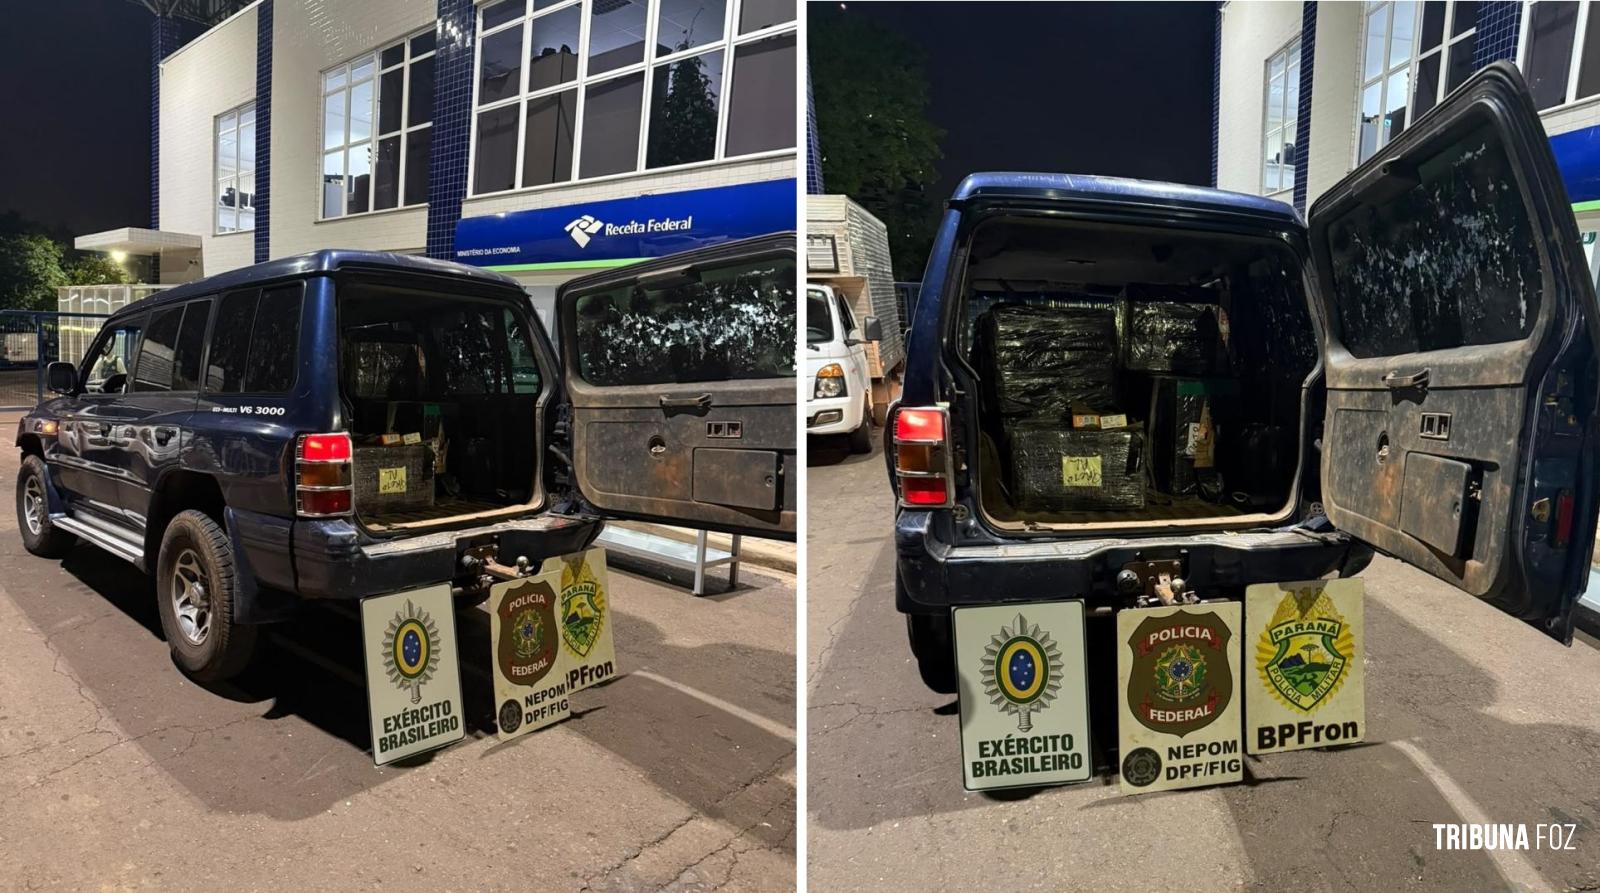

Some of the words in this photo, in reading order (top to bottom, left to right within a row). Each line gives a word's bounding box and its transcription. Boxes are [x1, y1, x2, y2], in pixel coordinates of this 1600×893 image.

[605, 220, 646, 236] Receita
[647, 215, 692, 232] Federal
[457, 248, 484, 257] MINISTÉRIO
[484, 248, 492, 256] DA
[492, 246, 520, 255] ECONOMIA
[240, 405, 253, 414] V6
[255, 406, 285, 416] 3000
[1273, 622, 1337, 641] PARANÁ
[511, 658, 549, 676] FEDERAL
[1311, 661, 1341, 701] MILITAR
[524, 683, 566, 708] NEPOM
[383, 699, 452, 734] EXÉRCITO
[525, 699, 569, 725] DPF/FIG
[1149, 705, 1212, 722] FEDERAL
[379, 715, 459, 753] BRASILEIRO
[978, 733, 1074, 758] EXÉRCITO
[1257, 720, 1359, 750] BPFron
[1168, 740, 1238, 760] NEPOM
[971, 752, 1083, 778] BRASILEIRO
[1165, 759, 1241, 780] DPF/FIG
